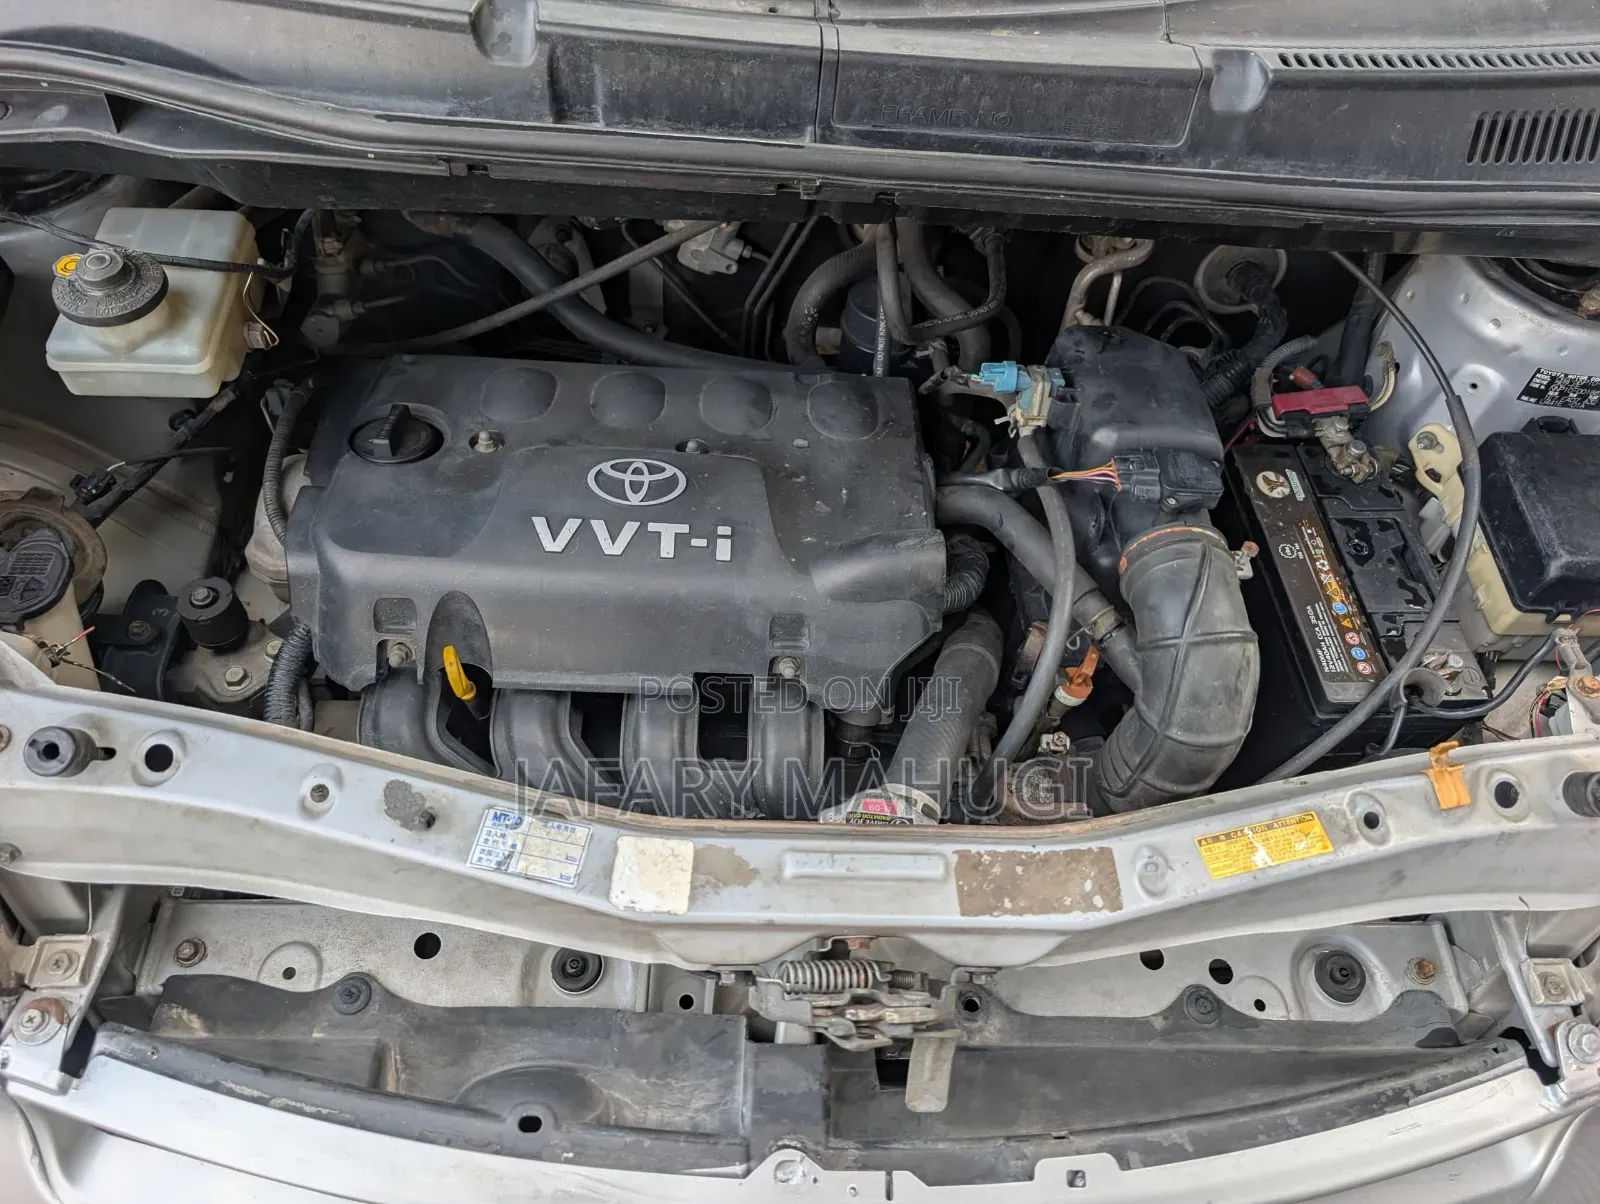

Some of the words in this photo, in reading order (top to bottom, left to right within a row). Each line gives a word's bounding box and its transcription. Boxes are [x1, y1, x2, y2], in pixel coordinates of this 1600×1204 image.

[882, 104, 964, 127] FRAME
[1540, 368, 1565, 378] TOYOTA
[1567, 374, 1589, 382] MOTOR
[531, 516, 732, 562] VVT-i
[1306, 605, 1318, 625] 350A
[1314, 626, 1324, 640] CCA
[1230, 825, 1269, 839] CAUION
[1272, 813, 1314, 829] ATTENTION
